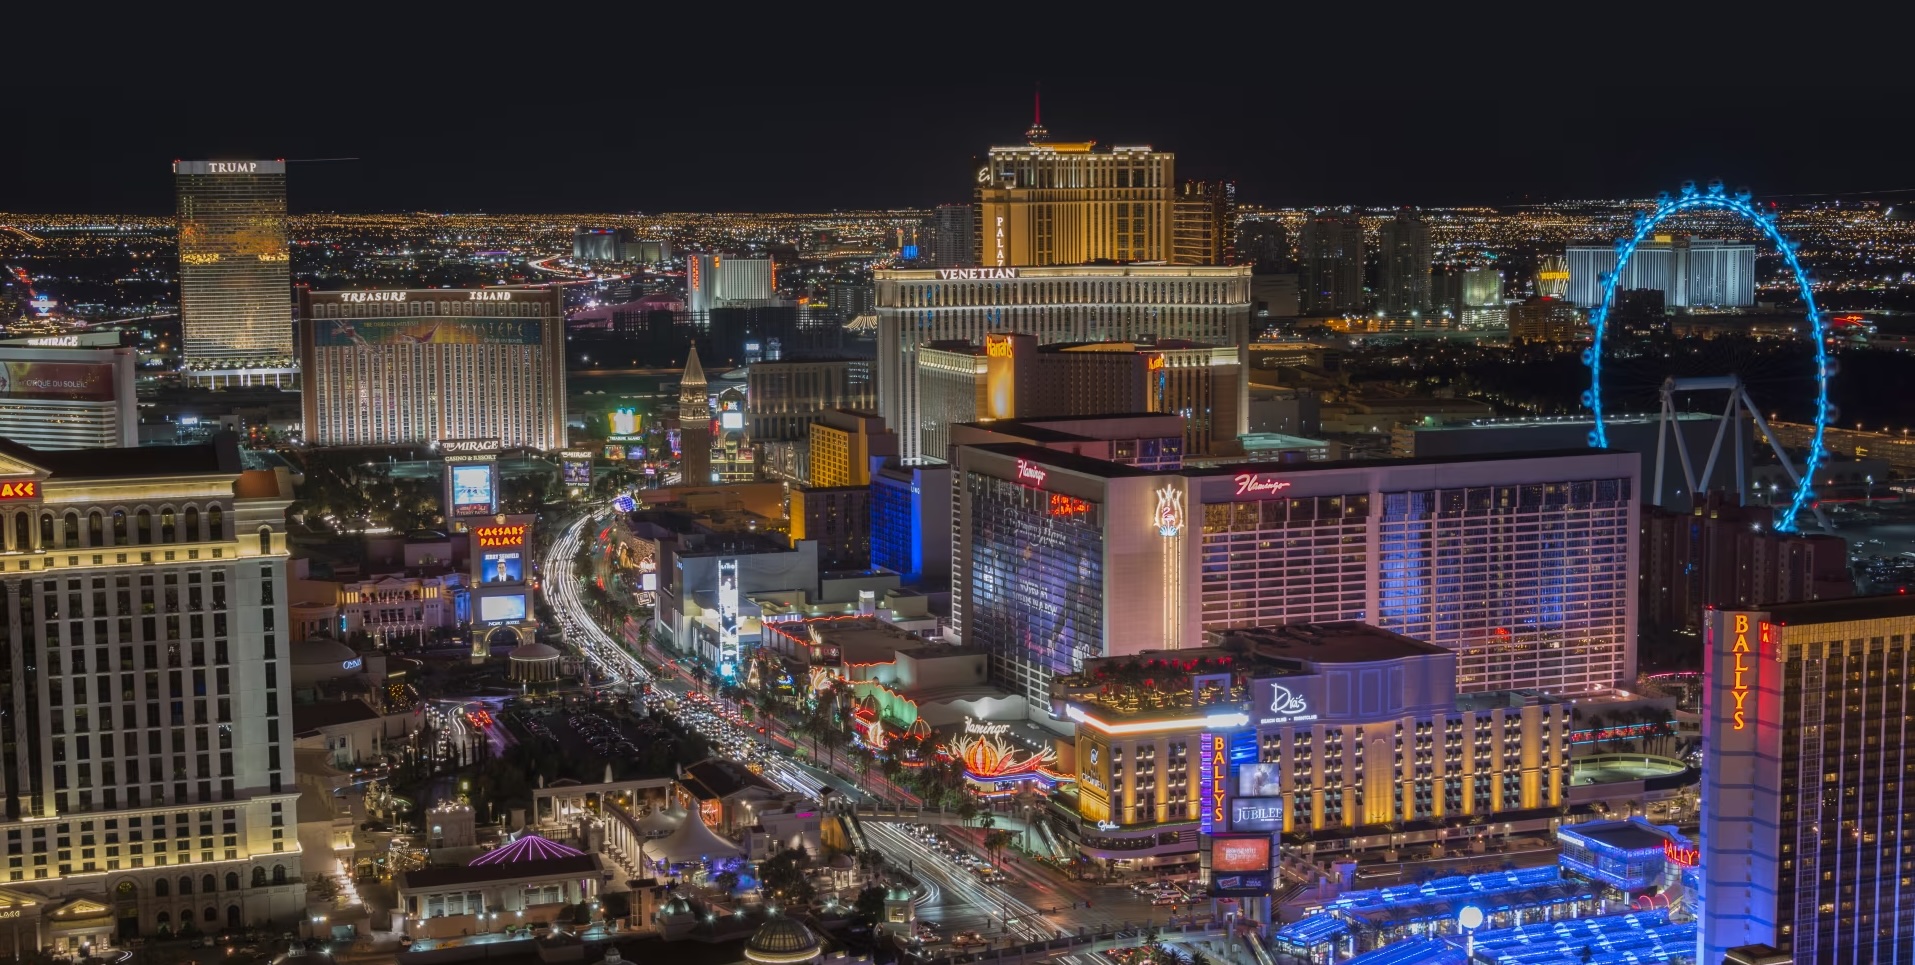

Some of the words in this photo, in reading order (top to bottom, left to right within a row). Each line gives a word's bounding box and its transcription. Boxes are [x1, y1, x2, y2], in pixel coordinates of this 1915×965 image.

[208, 162, 257, 173] TRUMP
[940, 267, 1016, 280] VENETIAN
[341, 291, 407, 303] TREASURE
[469, 291, 511, 301] ISLAND
[38, 336, 78, 346] MIRAGE
[27, 379, 52, 389] CIRQUE
[52, 380, 63, 388] DU
[442, 441, 456, 449] THE
[447, 440, 499, 452] MIRAGE
[444, 455, 467, 463] CASINO
[473, 454, 498, 462] RESORT
[1017, 459, 1046, 486] Flamingo
[1234, 474, 1291, 495] Flamingo
[477, 526, 525, 537] CAESARS
[480, 536, 523, 547] PALACE
[1731, 614, 1750, 730] BALLYS
[964, 715, 1011, 737] Flamingo
[1213, 736, 1226, 822] BALLYS
[1233, 807, 1283, 824] JUBILEE
[1664, 839, 1701, 866] ALLY'
